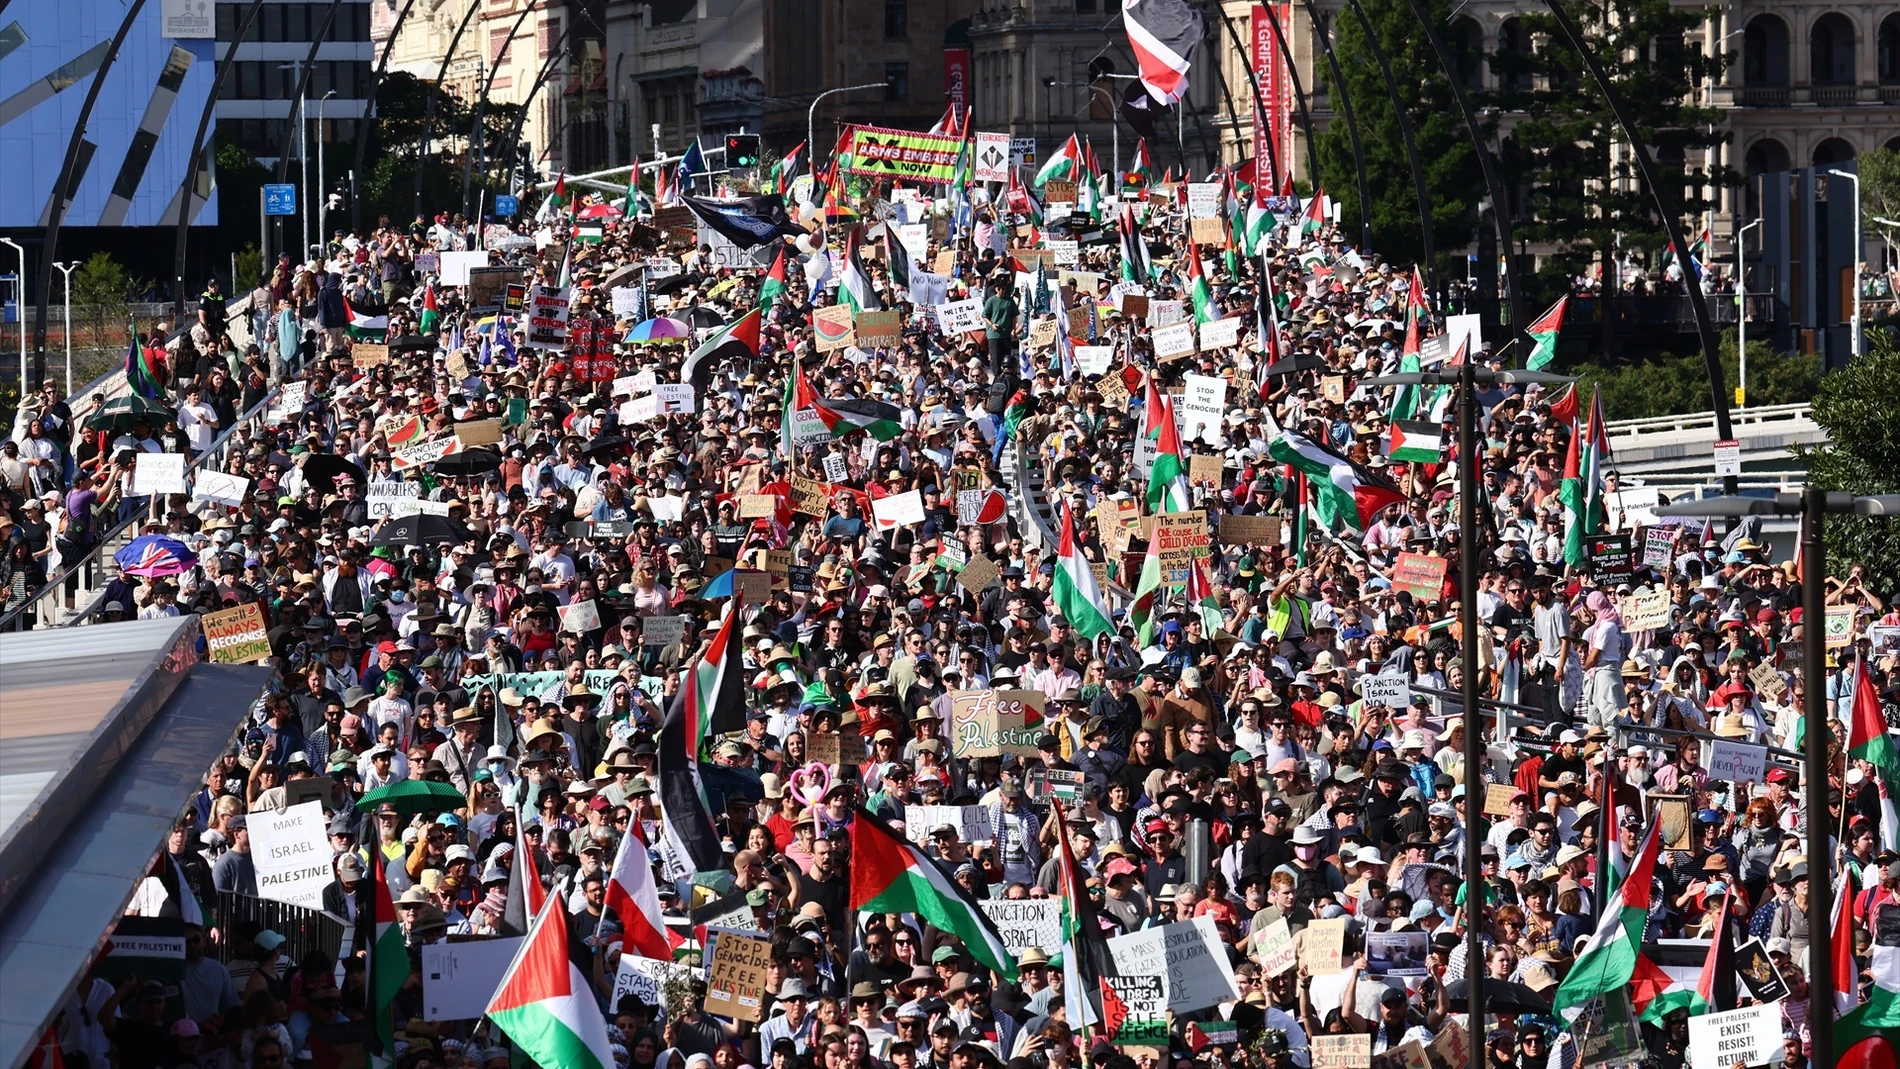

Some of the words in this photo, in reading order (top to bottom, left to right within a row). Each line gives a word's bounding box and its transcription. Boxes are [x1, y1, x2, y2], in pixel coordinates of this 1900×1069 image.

[1258, 29, 1272, 99] GRIFFITH
[859, 144, 900, 160] ARMS
[912, 275, 925, 284] NO
[539, 287, 562, 297] STOP
[534, 296, 569, 307] APARTHEID
[537, 309, 559, 319] STOP
[530, 317, 566, 329] GENOCIDE
[1038, 322, 1053, 333] FREE
[536, 327, 555, 336] FREE
[858, 334, 899, 348] DEMOCRACY
[1235, 366, 1251, 378] NOT
[1235, 379, 1244, 387] IN
[1186, 404, 1220, 414] GENOCIDE
[385, 421, 405, 432] FREE
[401, 438, 451, 459] SANCTIONS
[414, 452, 438, 464] NOW
[138, 461, 177, 469] GENOCIDE
[793, 477, 815, 490] NOT
[957, 471, 978, 487] NO
[957, 491, 979, 503] FREE
[741, 505, 773, 515] GENOCIDE
[797, 502, 825, 516] WONG
[1612, 505, 1626, 513] Free
[1627, 501, 1656, 511] Palestine
[1158, 516, 1174, 526] The
[1178, 513, 1203, 525] number
[1157, 528, 1172, 538] ONE
[1172, 527, 1193, 537] cause
[1194, 525, 1201, 535] of
[1649, 530, 1673, 541] STOP
[1159, 538, 1181, 550] CHILD
[1183, 535, 1209, 548] DEATHS
[950, 546, 962, 560] FREE
[1159, 551, 1181, 561] across
[1181, 549, 1190, 559] the
[768, 555, 790, 565] FREE
[940, 555, 963, 570] PALESTINE
[1161, 564, 1167, 572] in
[1166, 561, 1177, 571] the
[1177, 560, 1189, 570] Past
[1162, 574, 1169, 583] is
[1593, 574, 1608, 582] STOP
[206, 616, 223, 629] We
[227, 611, 247, 623] will
[208, 619, 259, 640] ALWAYS
[209, 629, 266, 651] RECOGNISE
[213, 640, 271, 664] PALESTINE
[1786, 650, 1796, 659] FREE
[1367, 688, 1399, 698] ISRAEL
[955, 690, 1024, 724] Free
[1365, 699, 1387, 708] NOW
[955, 720, 1043, 757] Palestine
[1047, 770, 1068, 780] FREE
[905, 808, 926, 825] FEED
[936, 807, 954, 822] THE
[272, 816, 304, 832] MAKE
[911, 825, 934, 842] SAVE
[271, 840, 315, 859] ISRAEL
[262, 864, 330, 887] PALESTINE
[285, 892, 316, 904] AGAIN
[1311, 927, 1340, 941] Imagine
[116, 941, 137, 950] FREE
[138, 942, 183, 953] PALESTINE
[1131, 942, 1156, 959] MASS
[1159, 928, 1208, 951] DESTRUCTION
[1257, 930, 1289, 958] SILENCE
[1308, 937, 1340, 952] Palestine
[714, 947, 769, 971] GENOCIDE
[1134, 956, 1163, 974] GAZA'S
[1164, 944, 1208, 967] EDUCATION
[1261, 948, 1295, 975] VIOLENCE
[1312, 949, 1331, 961] after
[717, 963, 757, 985] FREE
[1173, 966, 1183, 979] IS
[708, 976, 762, 999] PALESTINE
[1105, 976, 1157, 990] KILLING
[1102, 989, 1161, 1001] CHILDREN
[1114, 1001, 1130, 1014] IS
[1133, 1001, 1157, 1013] NOT
[1112, 1012, 1166, 1027] SELF-
[1708, 1014, 1725, 1027] FREE
[1725, 1009, 1762, 1023] PALESTINE
[1106, 1026, 1168, 1042] DEFENCE
[1720, 1021, 1751, 1037] EXIST!
[1352, 1037, 1370, 1047] KIDS
[1718, 1035, 1755, 1052] RESIST!
[1717, 1050, 1759, 1068] RETURN!
